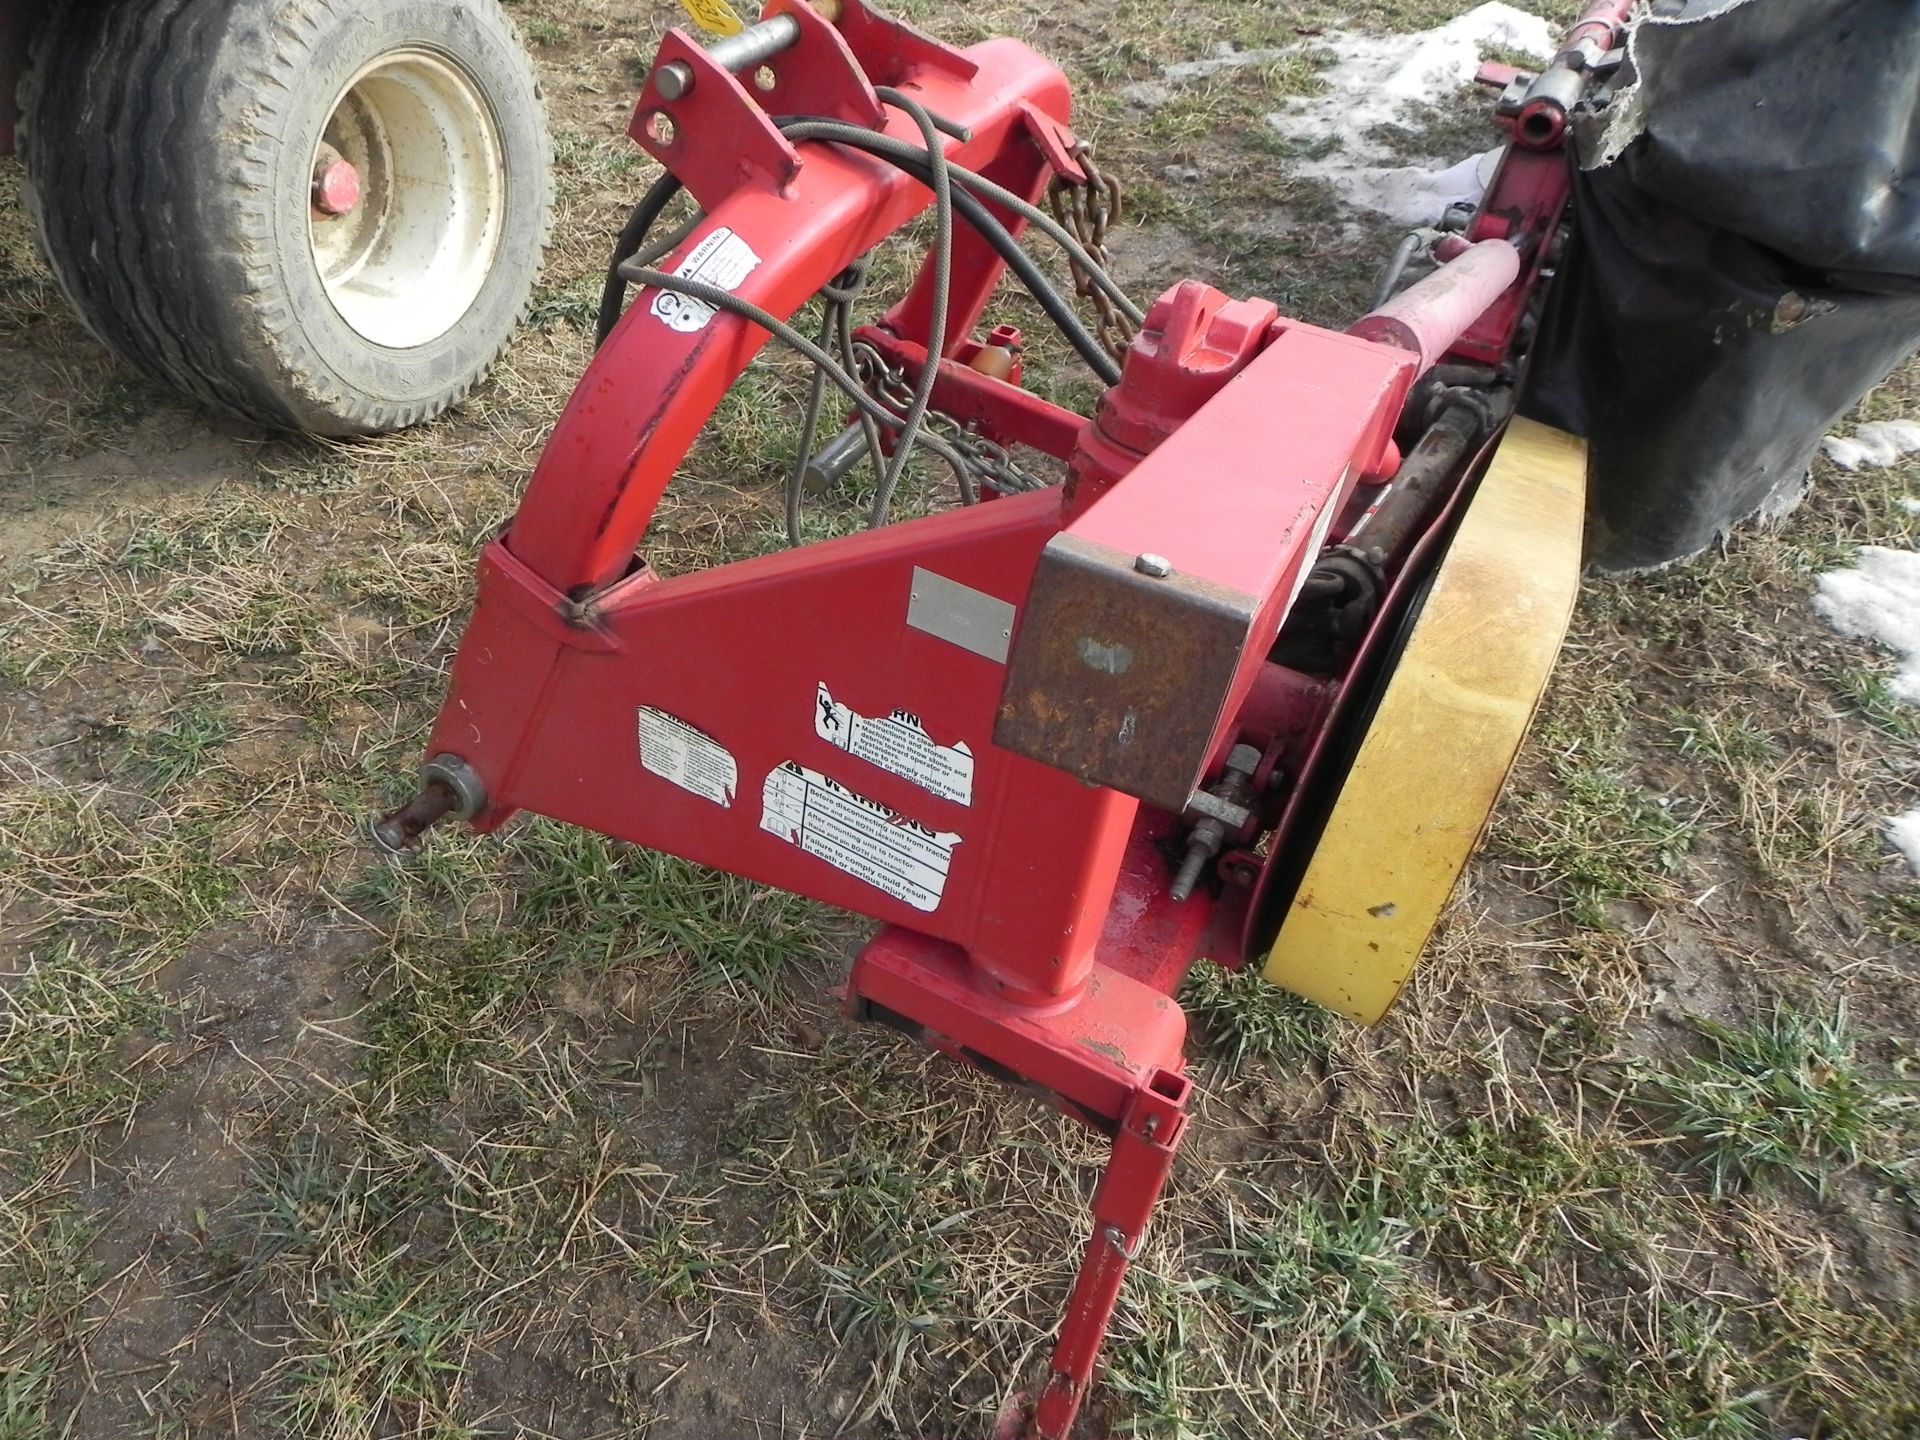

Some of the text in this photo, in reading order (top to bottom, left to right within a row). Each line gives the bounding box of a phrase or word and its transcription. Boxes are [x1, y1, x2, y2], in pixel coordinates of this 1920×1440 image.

[692, 229, 726, 264] WARNING
[859, 736, 900, 762] bystanders.
[860, 730, 949, 777] debris toward operator or
[861, 724, 967, 779] Machine can throw stones and
[862, 717, 906, 743] obstructions
[908, 738, 921, 750] and
[876, 717, 934, 749] machine to clear
[852, 747, 860, 755] in
[861, 751, 882, 766] death
[885, 763, 892, 771] or
[894, 767, 923, 786] serious
[853, 740, 965, 799] Failure to comply could result
[807, 810, 825, 825] After
[826, 820, 861, 844] mounting
[862, 838, 877, 851] unit
[878, 846, 887, 856] to
[809, 787, 834, 805] Before
[834, 799, 888, 833] disconnecting
[889, 826, 904, 840] unit
[905, 834, 924, 850] from
[810, 797, 829, 812] Lower
[830, 807, 842, 818] and
[843, 814, 854, 825] pin
[854, 819, 874, 834] BOTH
[807, 821, 825, 834] Raise
[826, 830, 838, 841] and
[839, 837, 849, 848] pin
[850, 842, 869, 857] BOTH
[804, 842, 812, 852] in
[814, 847, 837, 864] death
[838, 859, 847, 869] or
[849, 865, 880, 887] serious
[805, 833, 926, 902] Failure to comply could result
